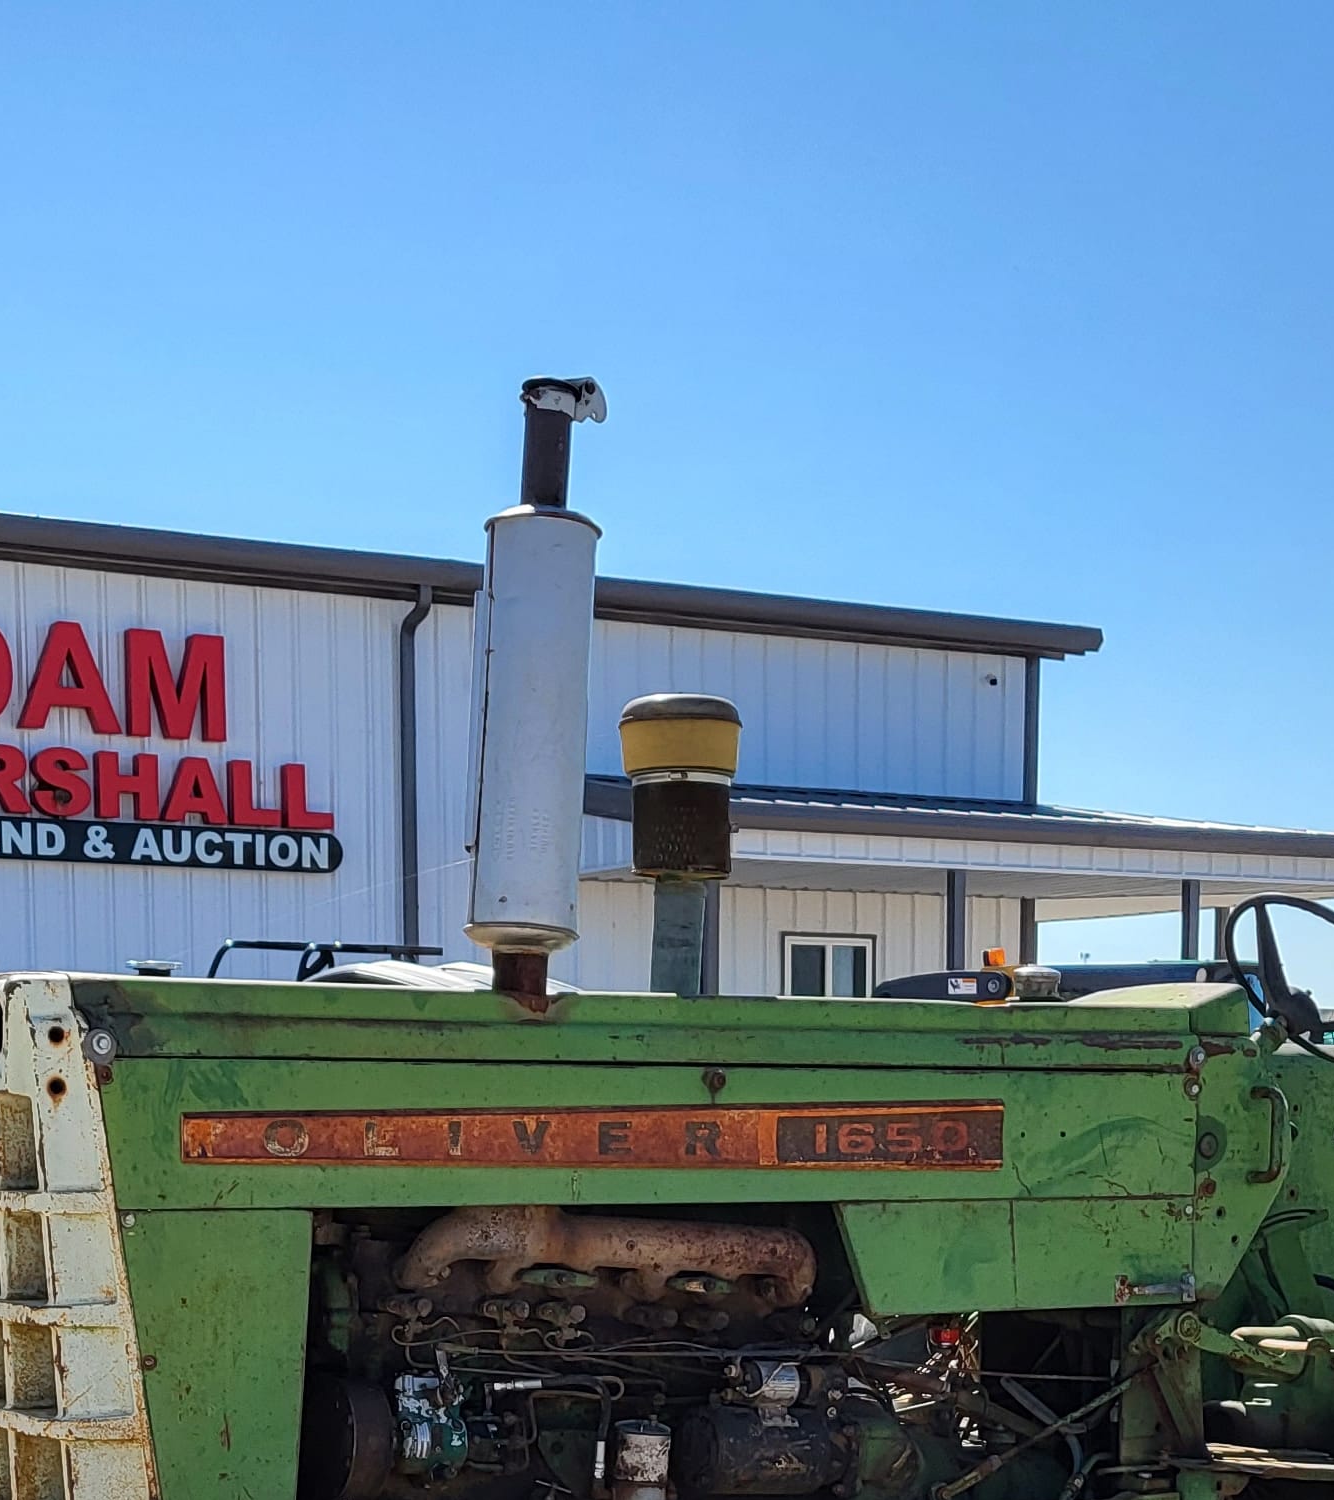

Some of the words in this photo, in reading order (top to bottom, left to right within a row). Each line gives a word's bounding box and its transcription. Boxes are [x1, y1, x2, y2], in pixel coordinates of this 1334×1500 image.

[83, 824, 117, 861] &
[131, 829, 331, 870] AUCTION
[262, 1117, 722, 1157] OLIVER
[814, 1119, 970, 1155] 1650
